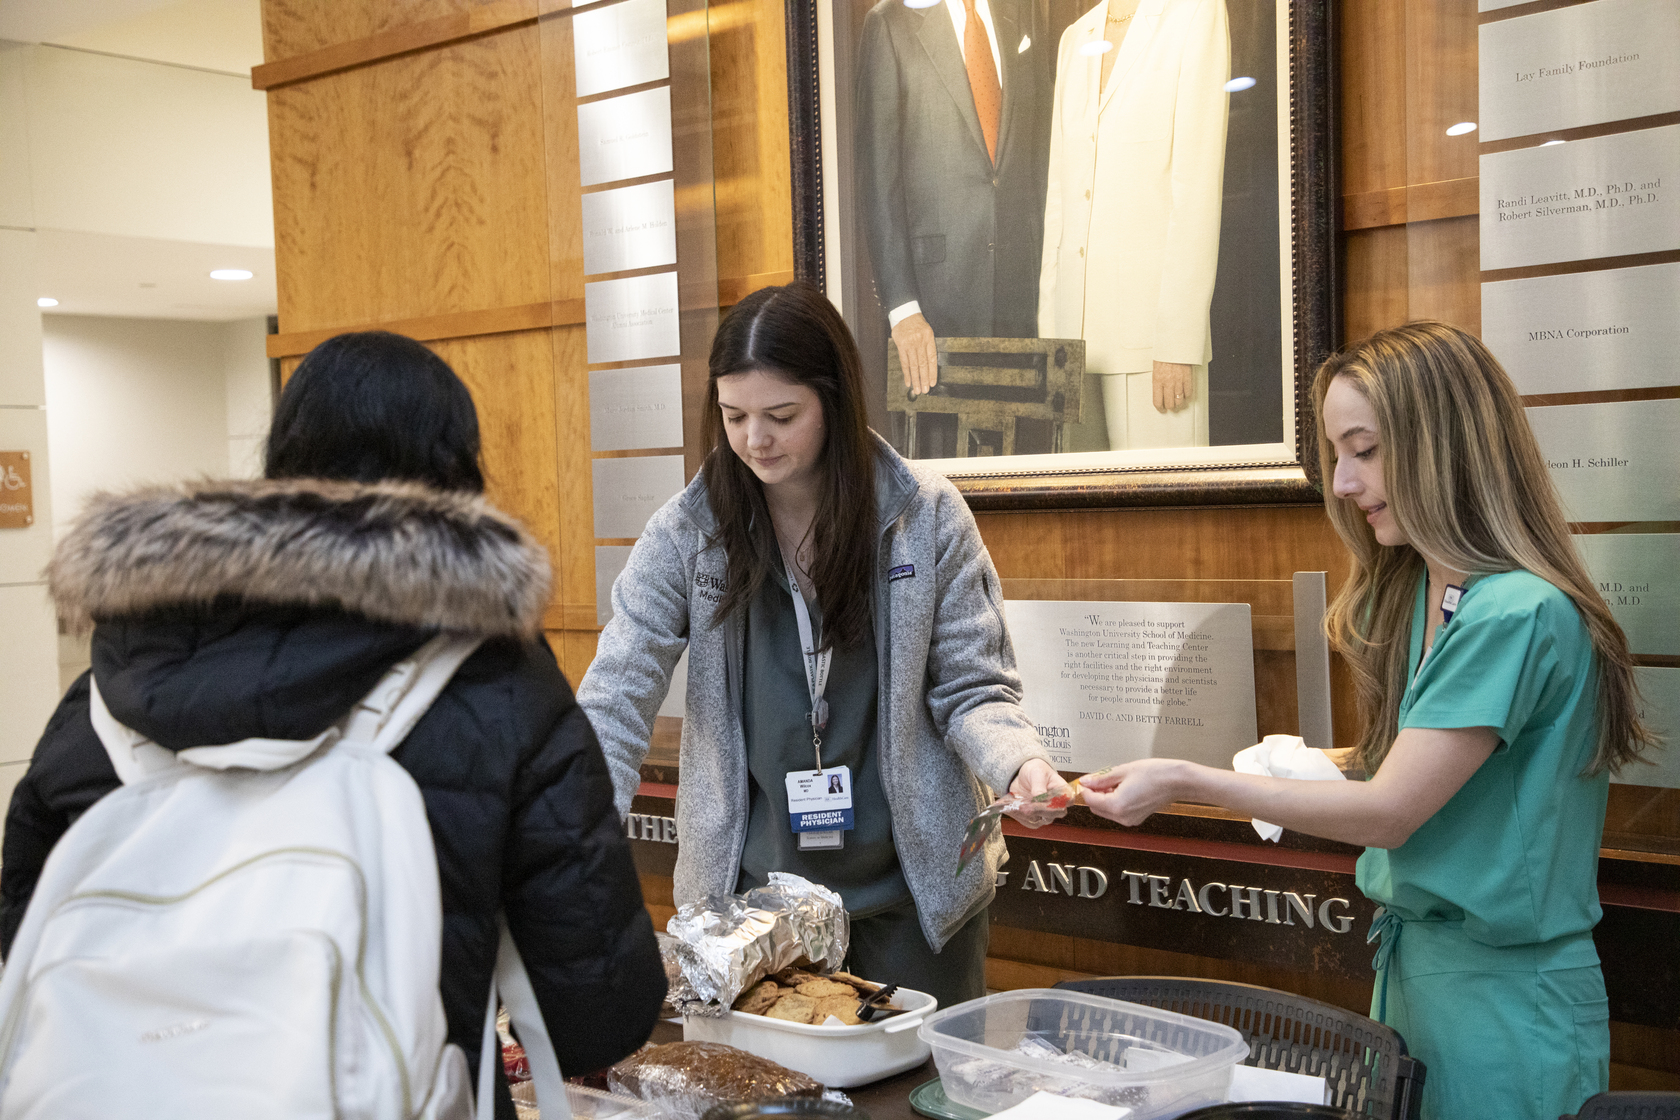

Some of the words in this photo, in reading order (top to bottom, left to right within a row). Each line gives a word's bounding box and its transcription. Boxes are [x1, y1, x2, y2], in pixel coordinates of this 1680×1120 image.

[1516, 72, 1535, 82] Lay
[1538, 64, 1575, 78] Family
[1578, 52, 1640, 71] Foundation
[1498, 196, 1527, 209] Randi
[1530, 192, 1570, 205] Leavitt,
[1574, 188, 1602, 199] M.D.,
[1606, 182, 1636, 194] Ph.D.
[1640, 178, 1661, 189] and
[1498, 210, 1532, 222] Robert
[1536, 204, 1592, 216] Silverman,
[1595, 199, 1624, 210] M.D.,
[1629, 193, 1659, 205] Ph.D.
[1528, 330, 1564, 342] MBNA
[1566, 325, 1630, 338] Corporation
[1572, 458, 1584, 468] H.
[1588, 458, 1629, 468] Schiller
[1600, 582, 1625, 592] M.D.
[1630, 583, 1650, 592] and
[1618, 596, 1643, 606] M.D.
[1118, 619, 1146, 628] pleased
[1156, 620, 1184, 629] support
[1060, 628, 1100, 638] Washington
[1102, 630, 1140, 639] University
[1142, 630, 1166, 639] School
[1168, 631, 1176, 639] of
[1177, 632, 1214, 640] Medicine.
[1065, 639, 1078, 647] The
[1098, 640, 1130, 650] Learning
[1147, 642, 1180, 651] Teaching
[1182, 643, 1208, 651] Center
[1104, 652, 1129, 660] critical
[1131, 653, 1146, 662] step
[1158, 654, 1194, 663] providing
[1064, 661, 1081, 670] right
[1083, 661, 1114, 670] facilities
[1144, 664, 1162, 673] right
[1164, 666, 1212, 674] environment
[1060, 671, 1070, 679] for
[1072, 672, 1110, 682] developing
[1125, 674, 1164, 684] physicians
[1166, 676, 1180, 684] and
[1182, 676, 1217, 686] scientists
[1080, 684, 1114, 693] necessary
[1125, 685, 1152, 694] provide
[1160, 687, 1182, 695] better
[1185, 688, 1197, 696] life
[1088, 694, 1098, 702] for
[1100, 695, 1123, 704] people
[1124, 696, 1150, 704] around
[1152, 697, 1165, 705] the
[1079, 712, 1104, 720] DAVID
[1106, 712, 1114, 720] C.
[1115, 714, 1134, 722] AND
[1136, 715, 1162, 724] BETTY
[1164, 716, 1204, 727] FARRELL
[800, 817, 844, 826] PHYSICIAN
[802, 811, 842, 820] RESIDENT
[1021, 859, 1108, 899] AND
[1120, 869, 1355, 934] TEACHING
